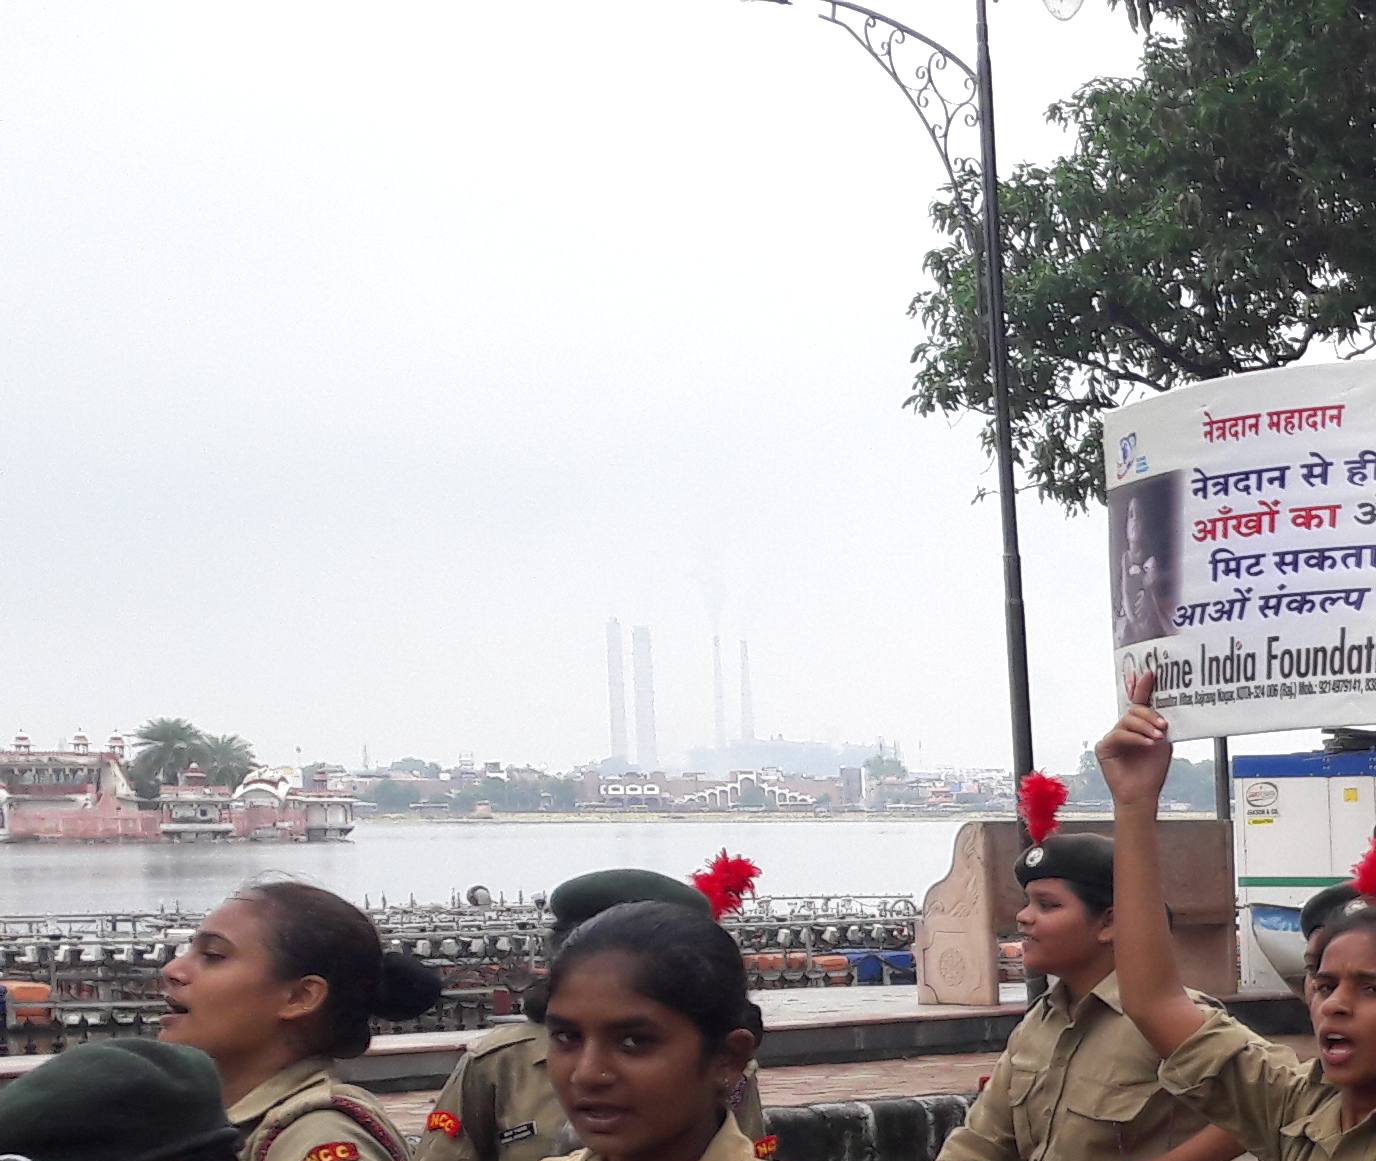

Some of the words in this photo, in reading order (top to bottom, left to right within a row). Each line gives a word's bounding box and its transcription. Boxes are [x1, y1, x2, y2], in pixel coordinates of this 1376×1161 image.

[1203, 412, 1261, 443] नेत्रदान
[1266, 404, 1345, 436] महादान
[1192, 467, 1290, 500] नेत्रदान
[1301, 452, 1333, 487] से
[1191, 499, 1279, 542] आँखों
[1289, 504, 1342, 531] का
[1209, 548, 1266, 582] मिट
[1172, 587, 1253, 628] आओं
[1259, 584, 1371, 619] संकल्प
[1200, 636, 1256, 687] India
[431, 1114, 455, 1132] NCC
